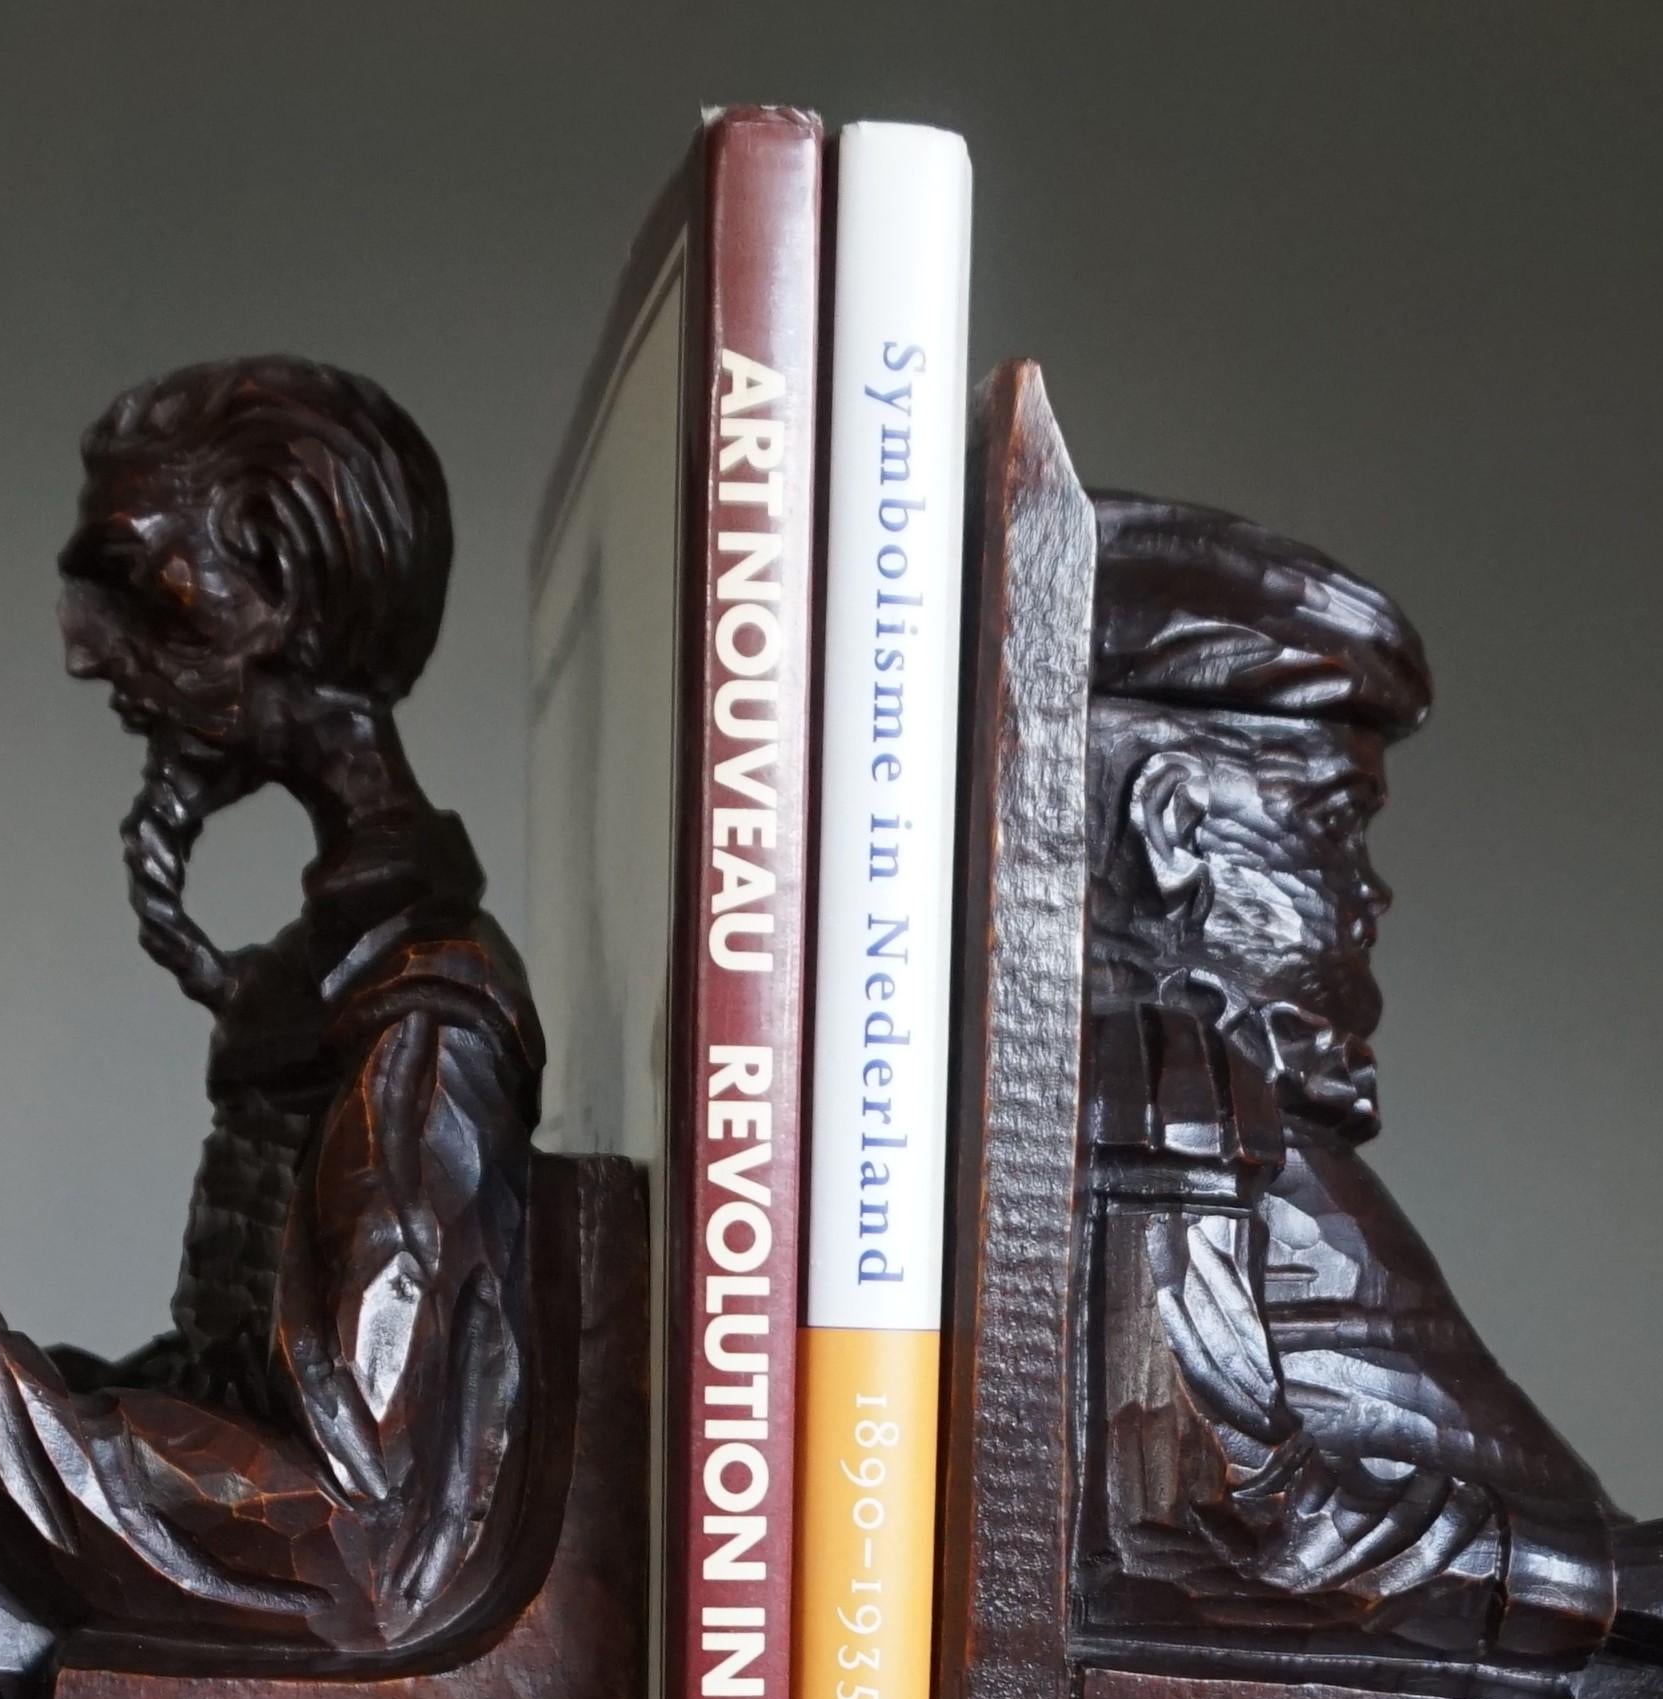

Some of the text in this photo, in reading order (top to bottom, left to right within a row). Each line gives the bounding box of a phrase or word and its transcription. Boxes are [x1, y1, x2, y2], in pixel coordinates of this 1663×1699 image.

[719, 348, 785, 517] ART
[709, 531, 782, 973] NOUVEAU
[857, 341, 927, 1287] Symbolisme in Nederland
[702, 1044, 773, 1581] REVOLUTION
[700, 1606, 766, 1697] IN
